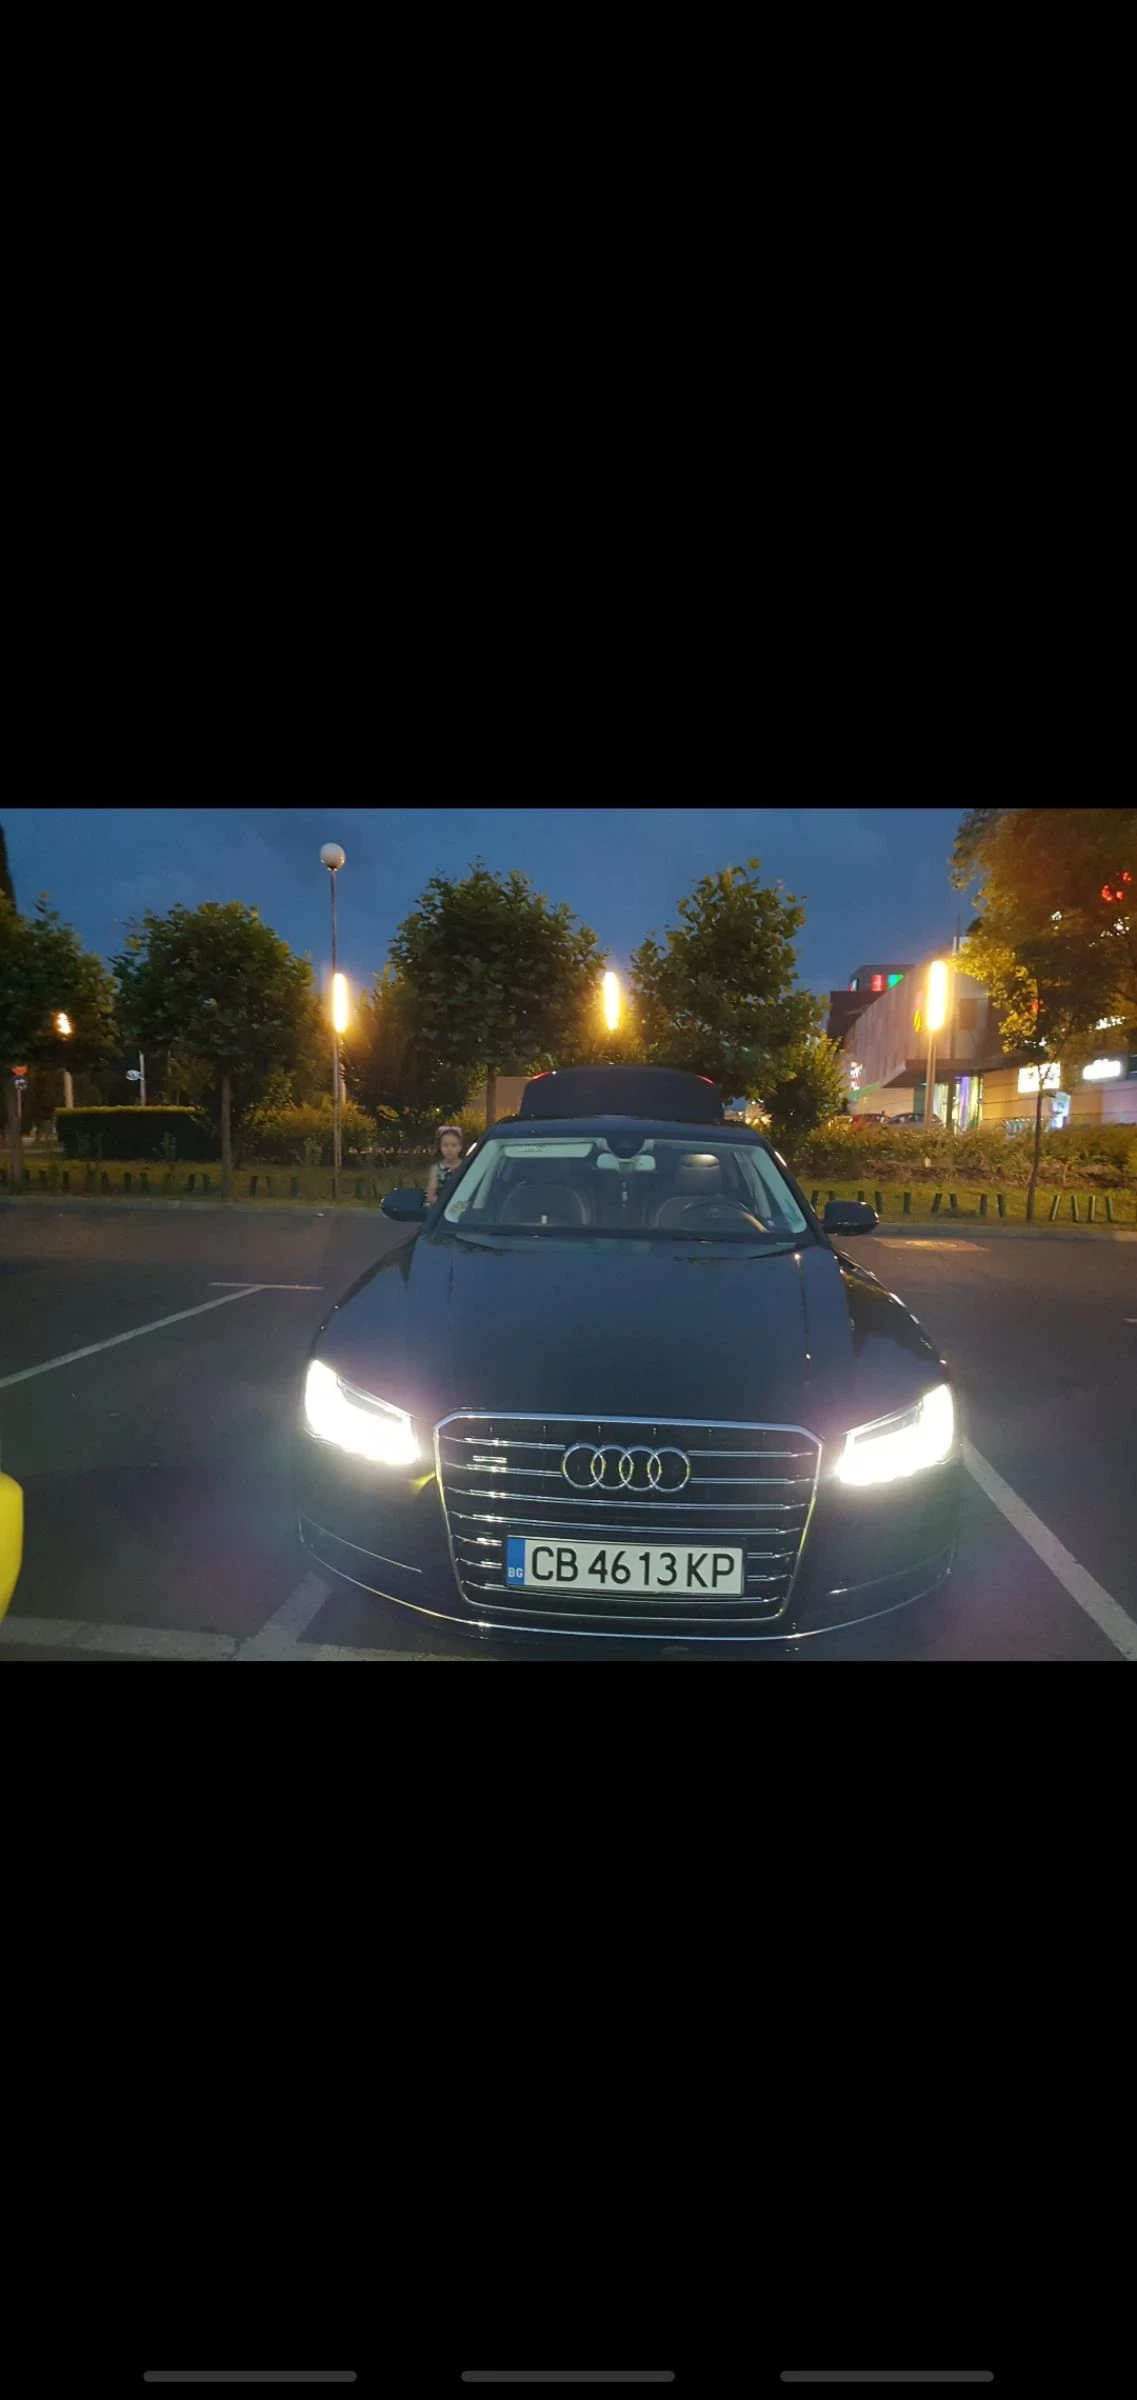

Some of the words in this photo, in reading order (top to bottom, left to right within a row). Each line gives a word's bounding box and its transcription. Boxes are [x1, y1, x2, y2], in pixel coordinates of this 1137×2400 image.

[507, 1567, 524, 1578] BG
[532, 1546, 578, 1581] CB
[588, 1550, 677, 1586] 4613
[687, 1553, 735, 1588] KP
